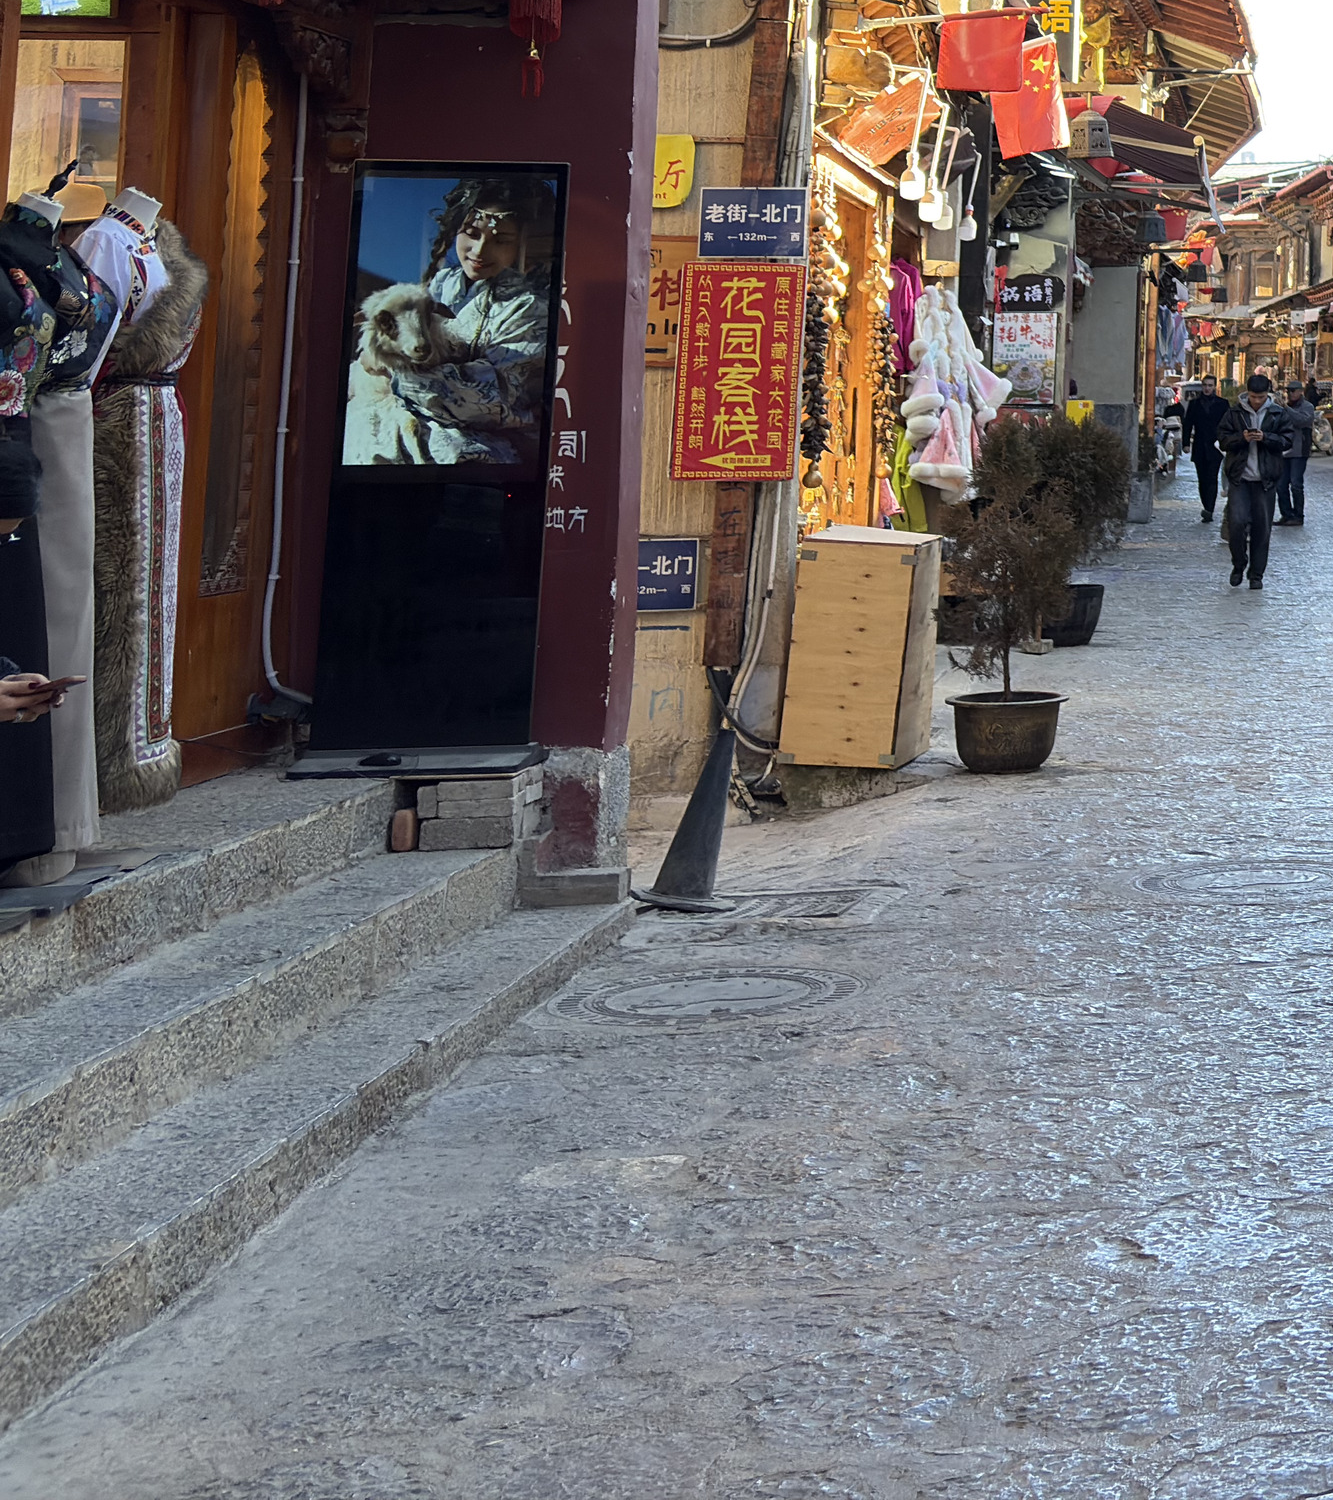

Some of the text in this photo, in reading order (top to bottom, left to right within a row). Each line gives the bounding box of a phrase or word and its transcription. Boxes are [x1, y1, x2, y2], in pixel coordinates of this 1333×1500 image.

[704, 232, 714, 242] 东
[711, 276, 766, 455] 花园客栈
[766, 276, 792, 451] 原住民藏家大花园
